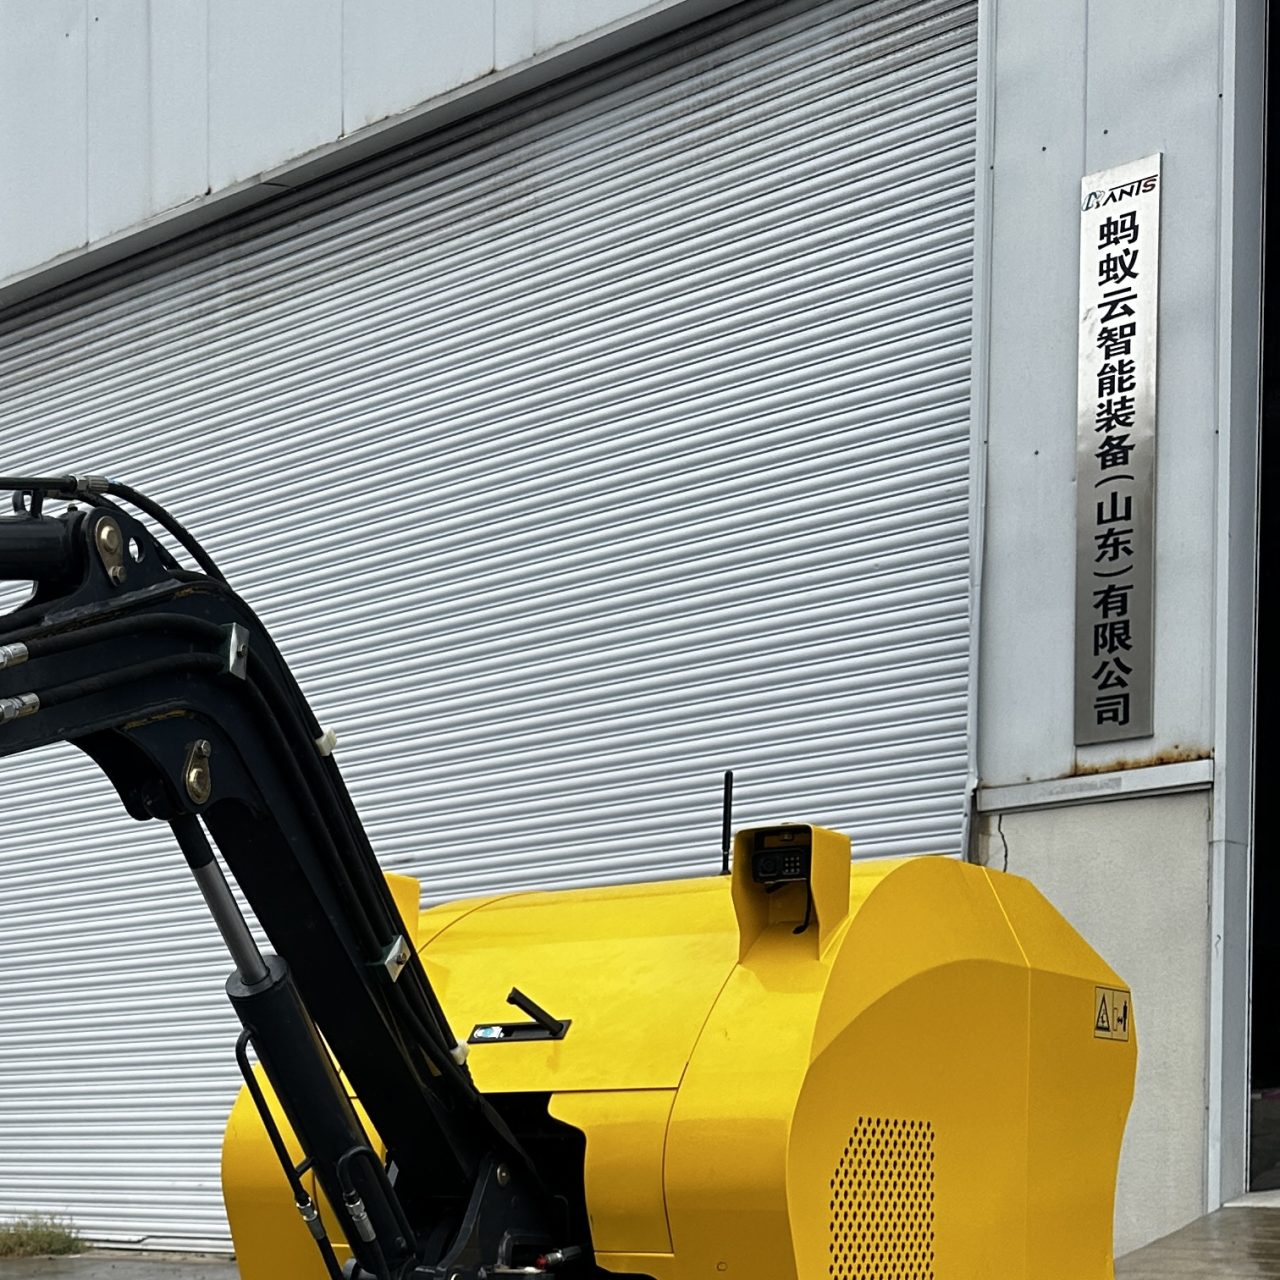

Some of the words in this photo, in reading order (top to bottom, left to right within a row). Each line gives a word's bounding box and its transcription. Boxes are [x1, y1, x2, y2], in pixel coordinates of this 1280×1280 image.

[1102, 174, 1158, 206] ANTS
[1091, 210, 1140, 726] 蚂蚁云智能装备（山东）有限公司
